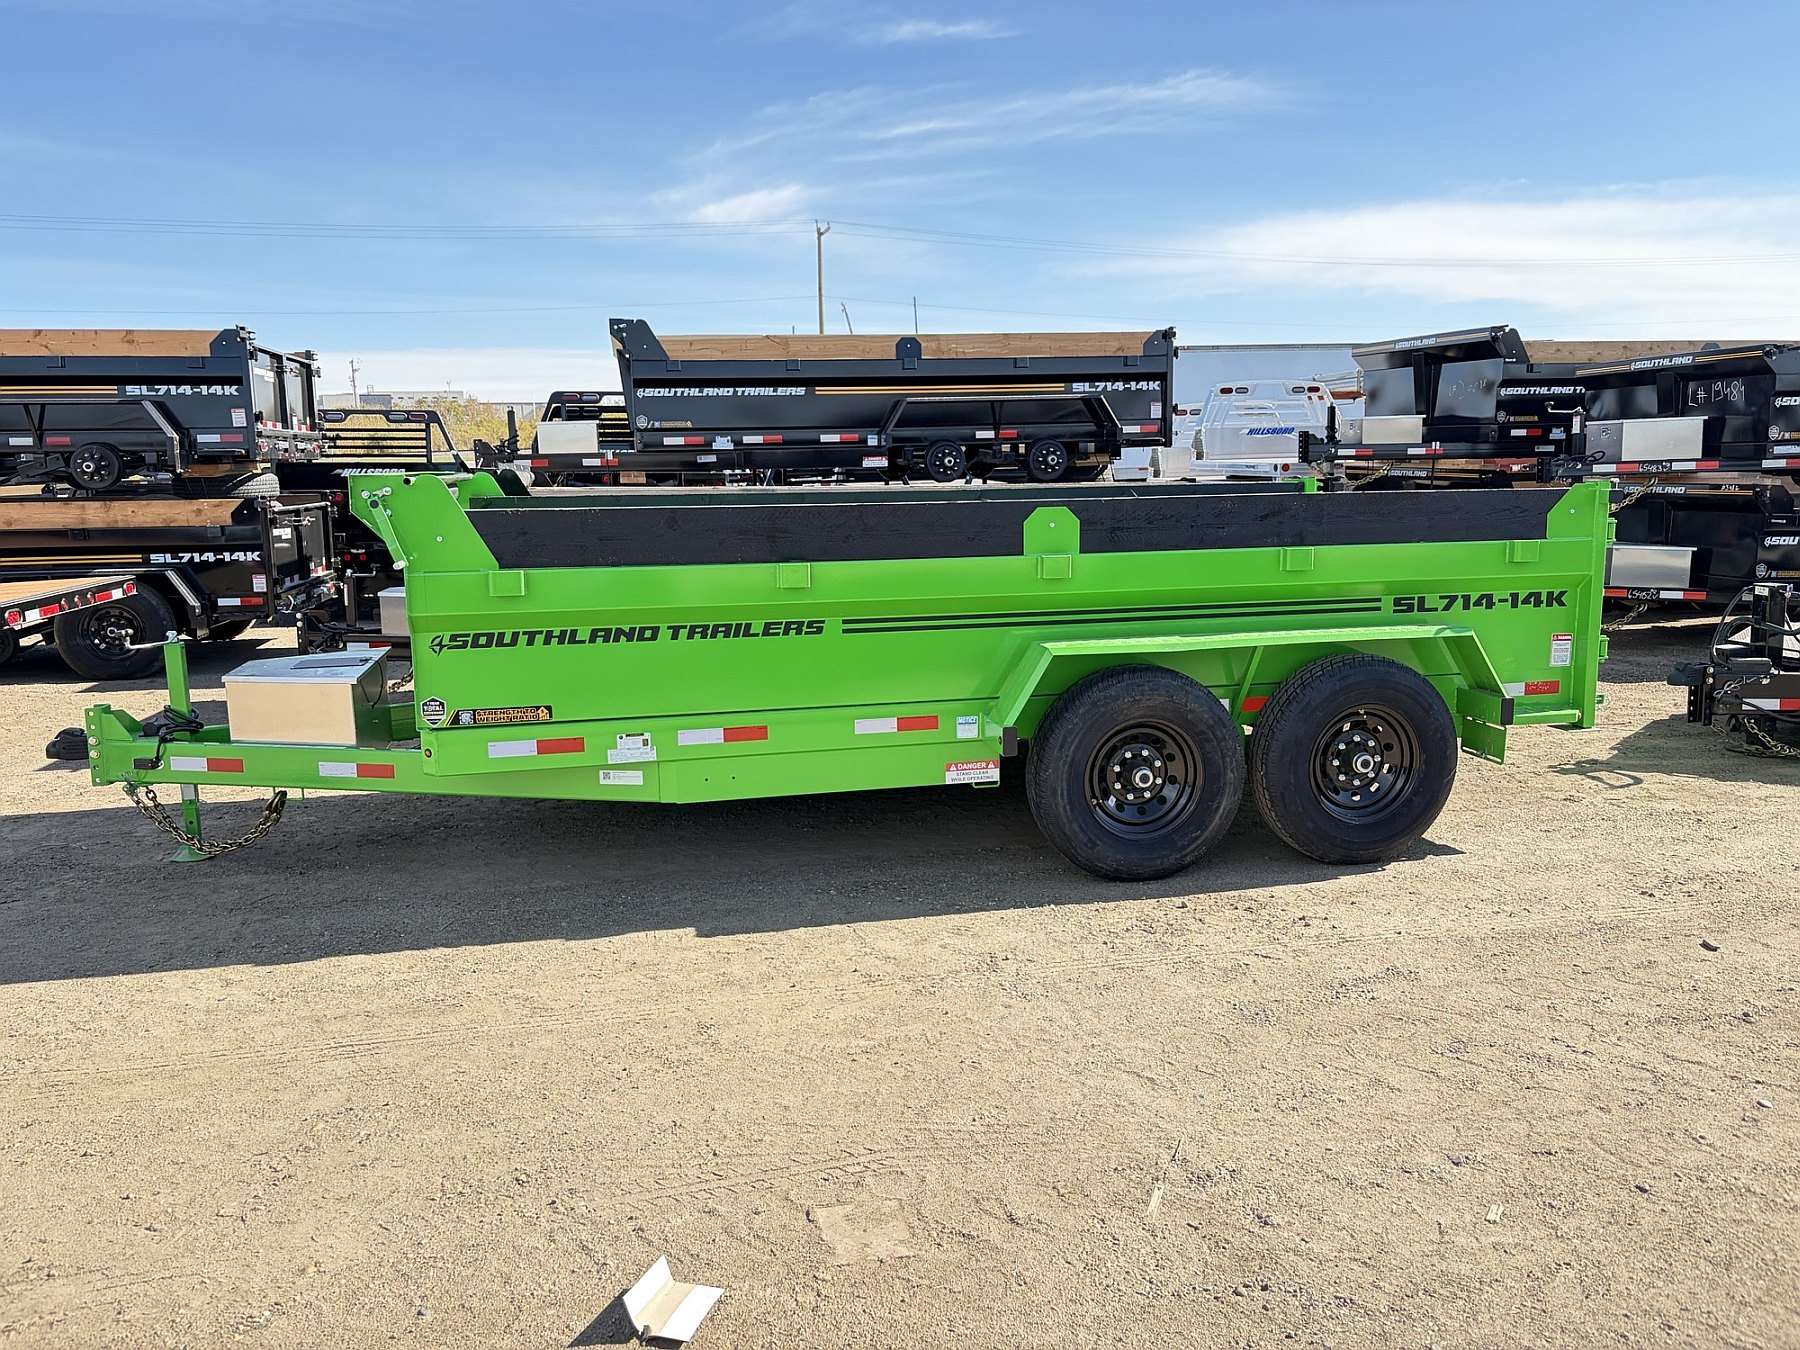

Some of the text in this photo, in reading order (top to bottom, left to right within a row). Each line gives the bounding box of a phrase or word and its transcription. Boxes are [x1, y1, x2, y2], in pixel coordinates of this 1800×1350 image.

[1396, 337, 1436, 349] SOUTHLAND
[1634, 355, 1694, 369] SOUTHLAND
[125, 384, 240, 396] SL714-14K
[645, 386, 807, 397] SOUTHLAND TRAILERS
[1072, 380, 1161, 393] SL714-14K
[1504, 386, 1575, 395] SOUTHLAND
[1247, 426, 1296, 436] HILLSBORO
[1389, 469, 1428, 478] SOUTHLAND
[149, 550, 262, 563] SL714-14K
[1392, 590, 1569, 614] SL714-14K
[446, 619, 826, 651] SOUTHLAND TRAILERS
[476, 713, 539, 723] WEIGHT RATIO
[957, 762, 987, 770] DANGER
